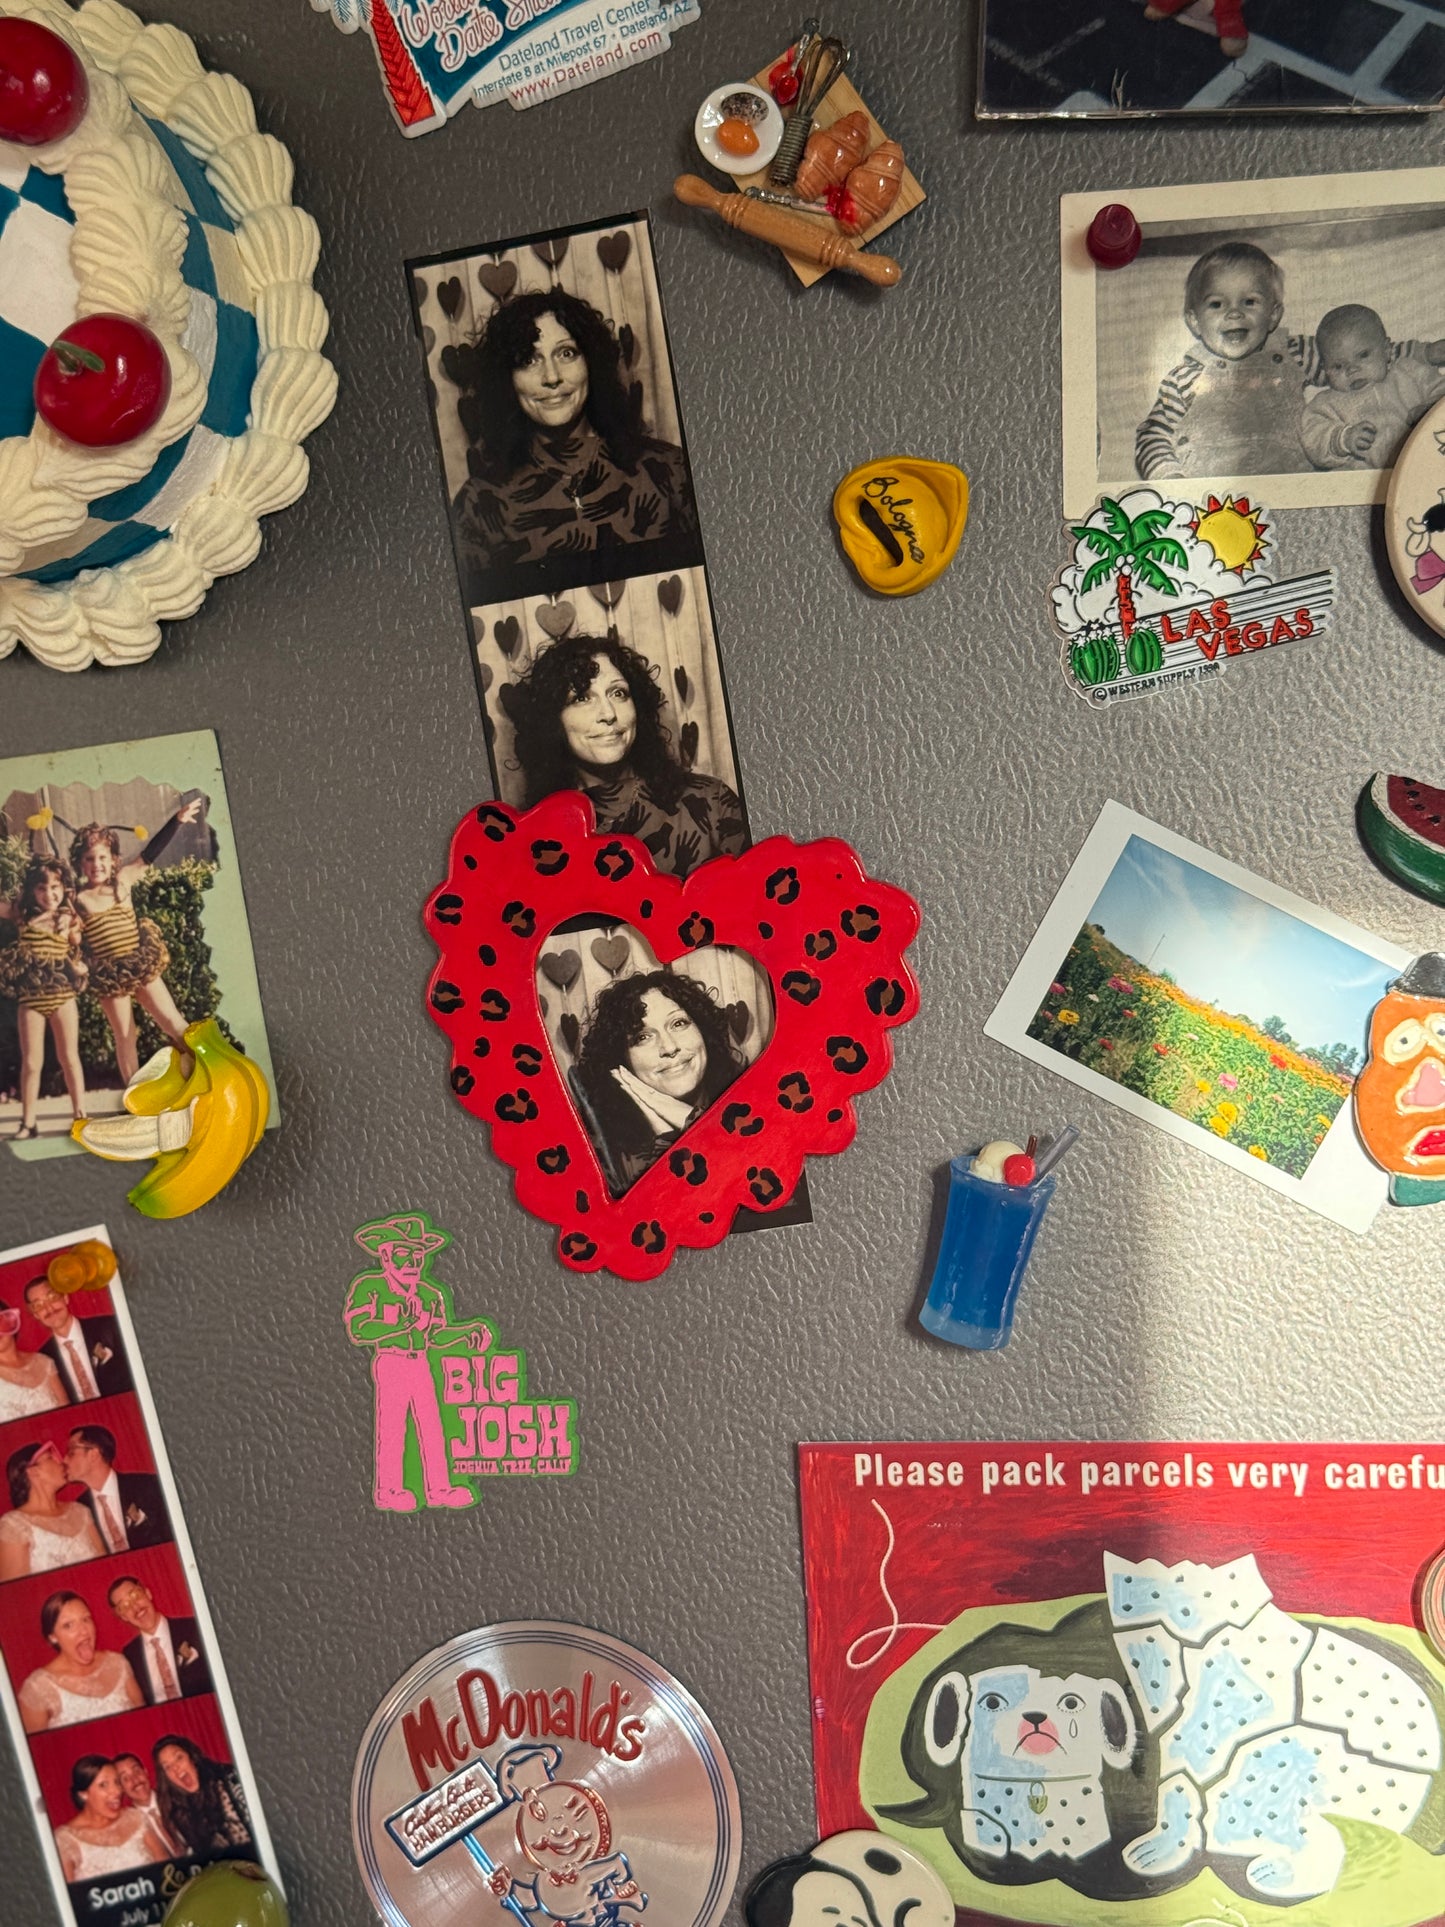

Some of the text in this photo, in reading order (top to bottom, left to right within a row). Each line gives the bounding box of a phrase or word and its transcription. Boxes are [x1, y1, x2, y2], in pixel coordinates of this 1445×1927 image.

[438, 8, 500, 69] Date
[473, 0, 692, 98] Interstate 8 at Milepost 67 Dateland, AZ
[500, 0, 651, 71] Dateland Travel Center
[510, 31, 662, 101] www.Dateland.com
[1161, 598, 1232, 644] LAS
[1196, 608, 1313, 661] VEGAS
[441, 1355, 519, 1404] BIG
[451, 1404, 571, 1459] JOSH
[453, 1460, 499, 1474] JOSHUA
[854, 1453, 964, 1487] Please
[982, 1452, 1066, 1494] pack
[1080, 1453, 1214, 1494] parcels
[1227, 1462, 1309, 1498] very
[402, 1668, 645, 1792] McDonald's
[89, 1877, 156, 1908] Sarah
[161, 1863, 185, 1896] &
[121, 1906, 149, 1926] July
